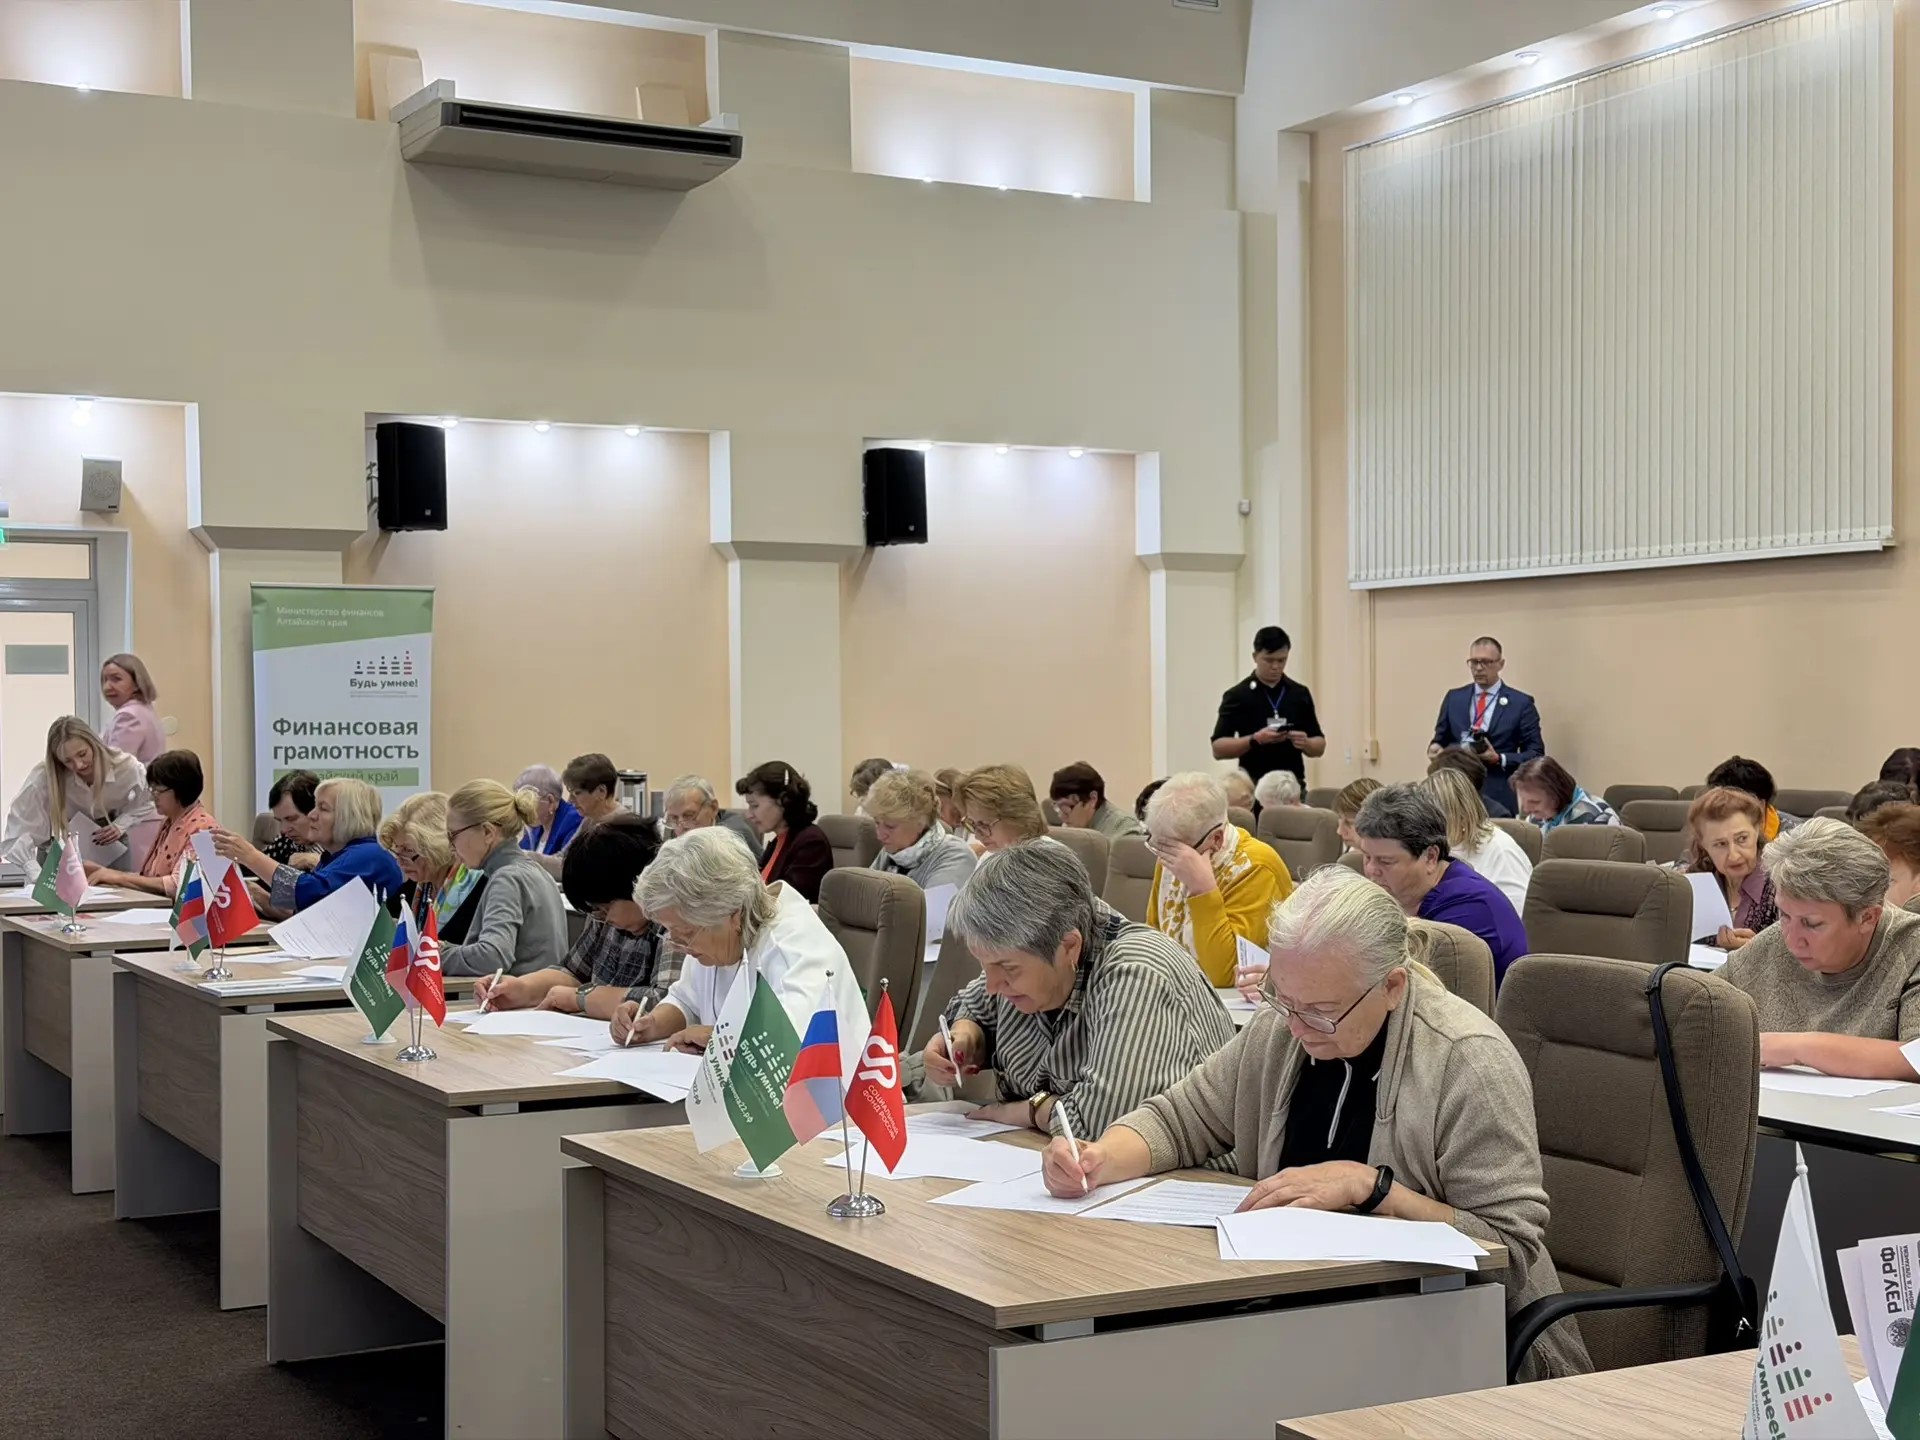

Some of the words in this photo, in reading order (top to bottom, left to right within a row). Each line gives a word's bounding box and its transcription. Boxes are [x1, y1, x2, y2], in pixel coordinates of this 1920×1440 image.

[276, 606, 339, 617] Министерство
[341, 608, 384, 618] финансов
[276, 617, 325, 626] Алтайского
[327, 619, 348, 628] края
[350, 678, 377, 689] Будь
[380, 678, 418, 689] умнее!
[272, 717, 418, 736] Финансовая
[273, 744, 419, 765] грамотность
[367, 770, 399, 784] край
[365, 947, 380, 970] Будь
[740, 1039, 758, 1069] Будь
[754, 1068, 783, 1109] умнее!
[862, 1089, 881, 1112] ФОНД
[879, 1111, 896, 1140] РОССИИ
[868, 1084, 899, 1135] СОЦИАЛЬНЫЙ
[1880, 1246, 1902, 1314] РЭУ.РФ
